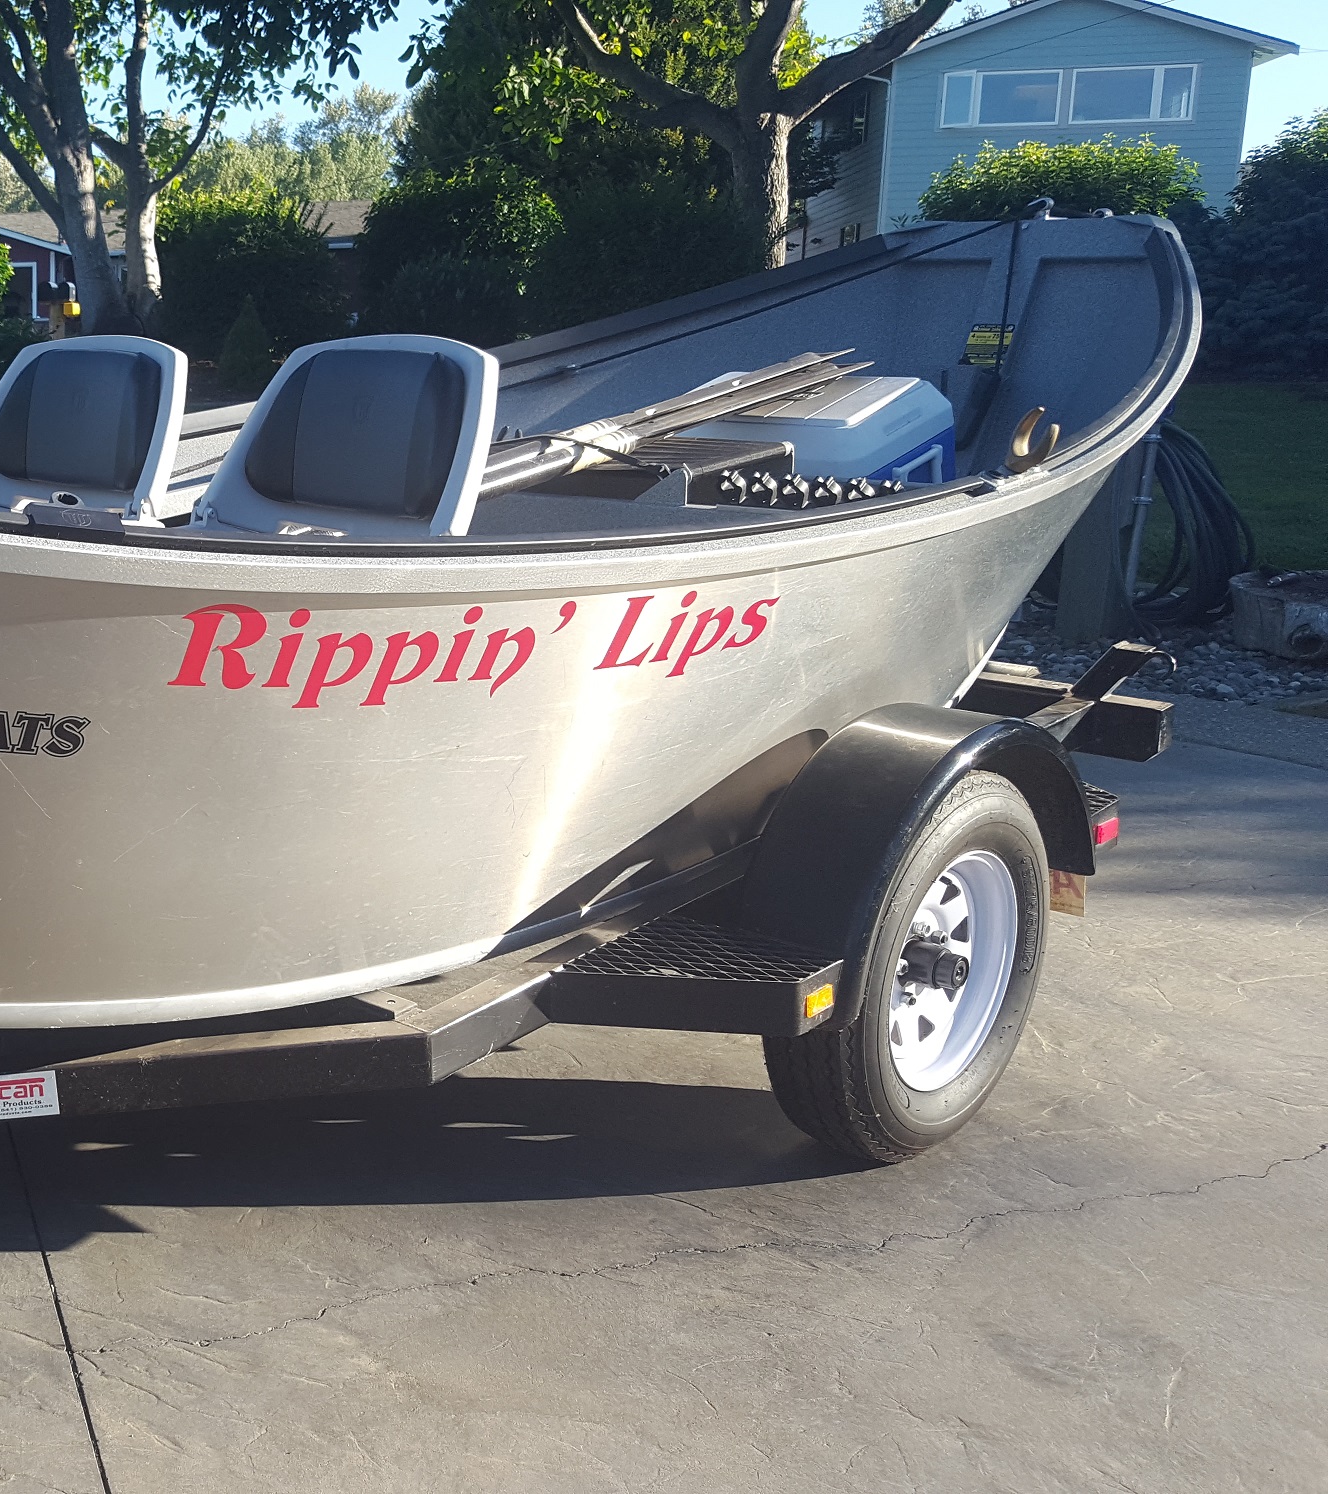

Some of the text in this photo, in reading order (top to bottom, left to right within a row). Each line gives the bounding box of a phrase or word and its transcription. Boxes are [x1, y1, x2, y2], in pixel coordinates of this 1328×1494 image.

[166, 590, 781, 709] Rippin' Lips
[3, 1099, 42, 1108] Products
